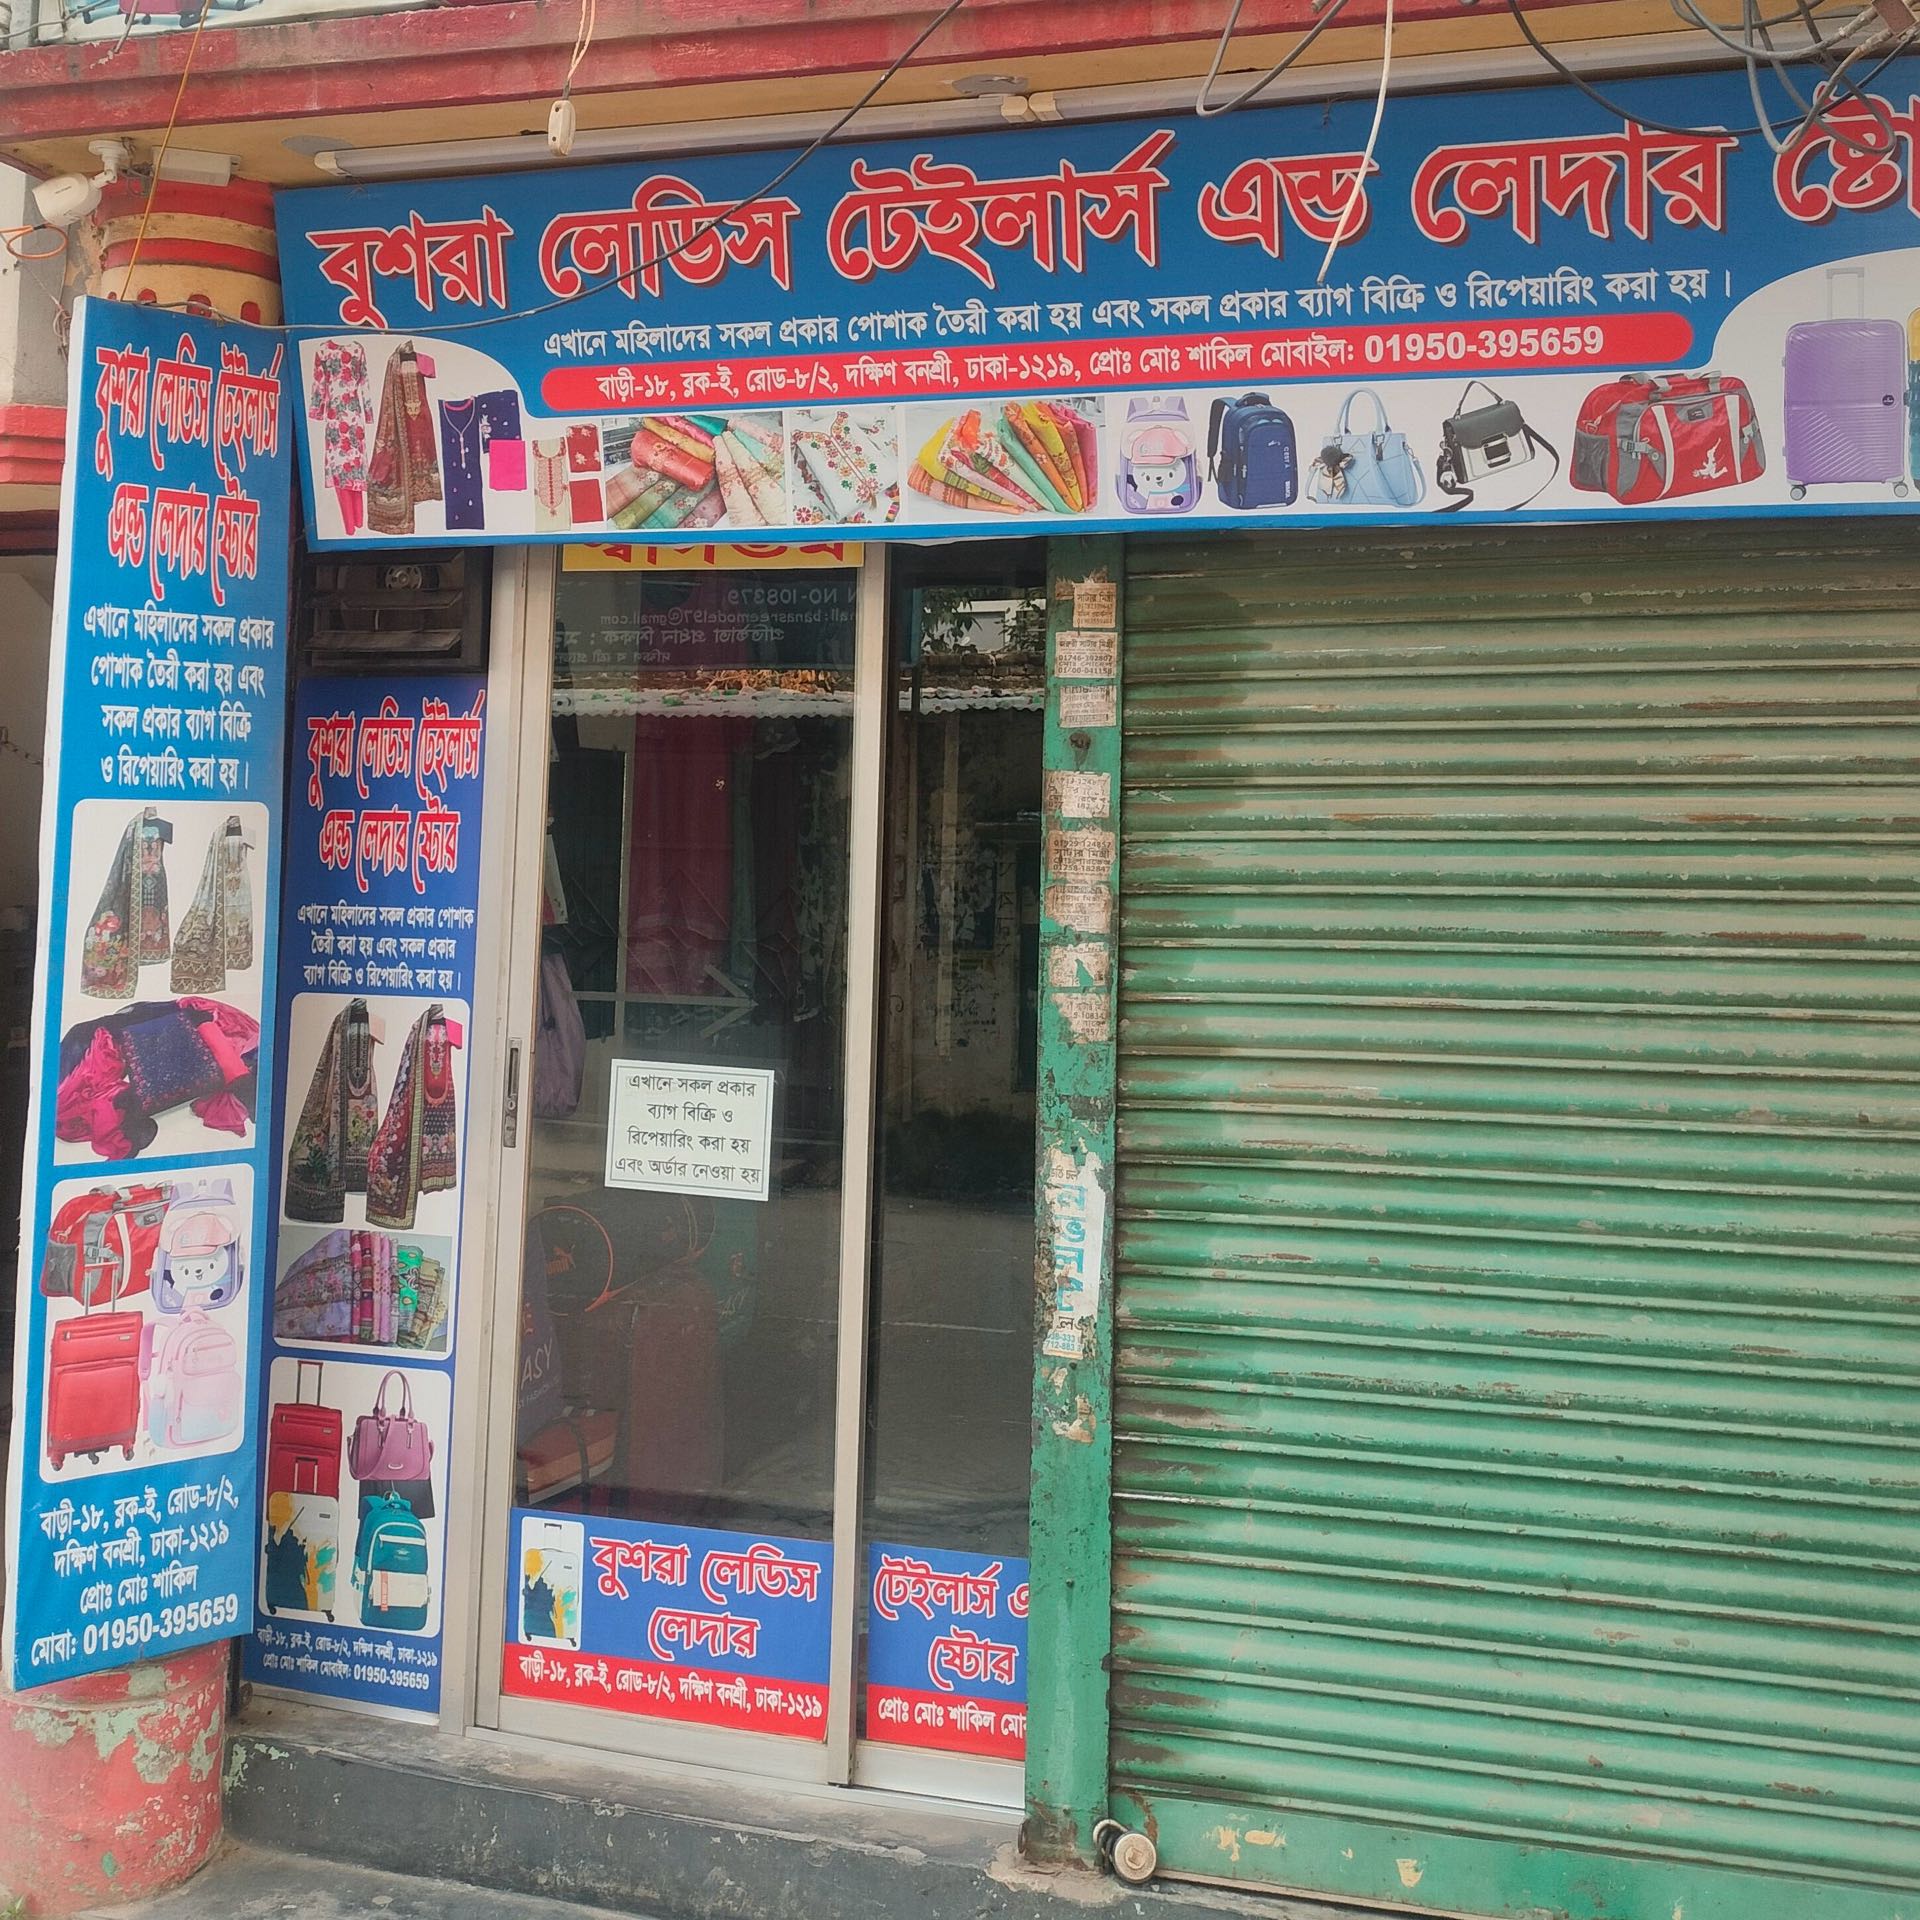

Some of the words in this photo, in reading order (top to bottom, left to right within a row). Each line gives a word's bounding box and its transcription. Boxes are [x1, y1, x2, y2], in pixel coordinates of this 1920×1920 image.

[306, 205, 514, 332] বুশরা
[538, 174, 802, 300] লেডিস
[827, 129, 1175, 290] টেইলার্স
[1411, 118, 1737, 246] লেদার
[544, 329, 606, 359] এখানে
[613, 321, 709, 357] মহিলাদের
[719, 324, 771, 350] সকল
[779, 317, 839, 348] প্রকার
[849, 308, 927, 344] পোশাক
[936, 300, 987, 337] তৈরী
[996, 306, 1039, 334] করা
[1047, 303, 1081, 333] হয়
[1093, 301, 1140, 328] এবং
[1149, 296, 1210, 323] সকল
[1220, 290, 1286, 320] প্রকার
[1295, 284, 1352, 317] ব্যাগ
[1361, 276, 1424, 314] বিক্রি
[1436, 286, 1457, 305] ও
[1466, 267, 1594, 309] রিপেয়ারিং
[1604, 269, 1658, 300] করা
[596, 366, 676, 405] বাড়ী-১৮,
[682, 361, 739, 403] ব্লক-ই,
[746, 357, 838, 394] রোড-৮/২,
[844, 357, 898, 389] দক্ষিণ
[903, 349, 960, 387] বনশ্রী,
[967, 347, 1082, 383] ঢাকা-১২১৯,
[1089, 347, 1132, 375] প্রোঃ
[1140, 343, 1180, 373] মোঃ
[1189, 334, 1251, 367] শাকিল
[1364, 326, 1605, 364] 01950-395659
[95, 343, 150, 481] বুশরা
[150, 332, 213, 471] লেডিস
[215, 341, 284, 479] টেইলার্স
[150, 482, 210, 602] লেদার
[84, 603, 130, 640] এখানে
[132, 600, 198, 647] মহিলাদের
[201, 614, 236, 647] সকল
[238, 615, 275, 650] প্রকার
[91, 652, 144, 689] পোশাক
[147, 648, 180, 692] তৈরী
[183, 659, 211, 694] করা
[213, 662, 235, 698] হয়
[237, 663, 266, 699] এবং
[101, 704, 139, 738] সকল
[142, 704, 181, 740] প্রকার
[184, 706, 217, 742] ব্যাগ
[219, 700, 252, 743] বিক্রি
[101, 756, 113, 784] ও
[117, 744, 185, 791] রিপেয়ারিং
[188, 755, 216, 790] করা
[307, 710, 356, 812] বুশরা
[355, 695, 415, 799] লেডিস
[415, 689, 485, 799] টেইলার্স
[355, 803, 412, 894] লেদার
[297, 901, 328, 926] এখানে
[331, 900, 376, 929] মহিলাদের
[379, 905, 404, 926] সকল
[407, 906, 435, 928] প্রকার
[438, 905, 475, 930] পোশাক
[311, 928, 334, 955] তৈরী
[337, 933, 356, 957] করা
[359, 937, 374, 958] হয়
[377, 938, 398, 958] এবং
[400, 938, 424, 959] সকল
[428, 938, 456, 960] প্রকার
[303, 962, 326, 986] ব্যাগ
[327, 958, 352, 987] বিক্রি
[354, 966, 365, 985] ও
[366, 961, 414, 990] রিপেয়ারিং
[416, 966, 436, 989] করা
[629, 1074, 673, 1092] এখানে
[677, 1077, 712, 1094] সকল
[716, 1080, 756, 1098] প্রকার
[647, 1103, 678, 1121] ব্যাগ
[684, 1101, 716, 1122] বিক্রি
[722, 1111, 733, 1123] ও
[627, 1125, 694, 1150] রিপেয়ারিং
[698, 1135, 726, 1152] করা
[730, 1137, 751, 1155] হয়
[615, 1158, 644, 1175] এবং
[648, 1156, 689, 1176] অর্ডার
[692, 1164, 735, 1181] নেওয়া
[740, 1168, 762, 1184] হয়
[39, 1497, 108, 1541] বাড়ী-১৮,
[113, 1485, 162, 1529] ব্লক-ই,
[167, 1474, 240, 1517] রোড-৮/২,
[53, 1540, 99, 1578] দক্ষিণ
[102, 1527, 146, 1569] বনশ্রী,
[150, 1519, 230, 1560] ঢাকা-১২১৯
[589, 1536, 690, 1599] বুশরা
[699, 1542, 820, 1605] লেডিস
[80, 1580, 113, 1616] প্রোঃ
[117, 1573, 148, 1607] মোঃ
[151, 1559, 199, 1599] শাকিল
[873, 1554, 1003, 1621] টেইলার্স
[83, 1593, 238, 1655] 01950-395659
[647, 1607, 761, 1661] লেদার
[296, 1653, 318, 1675] শাকিল
[354, 1664, 430, 1690] 01950-395659
[353, 1638, 374, 1658] দক্ষিণ
[397, 1646, 438, 1668] ঢাকা-১২১৯
[519, 1649, 571, 1689] বাড়ী-১৮,
[574, 1661, 613, 1693] ব্লক-ই,
[615, 1668, 675, 1704] রোড-৮/২,
[679, 1670, 713, 1704] দক্ষিণ
[716, 1676, 751, 1714] বনশ্রী,
[754, 1686, 823, 1720] ঢাকা-১২১৯
[878, 1698, 909, 1723] প্রোঃ
[914, 1701, 944, 1727] মোঃ
[946, 1701, 996, 1734] শাকিল
